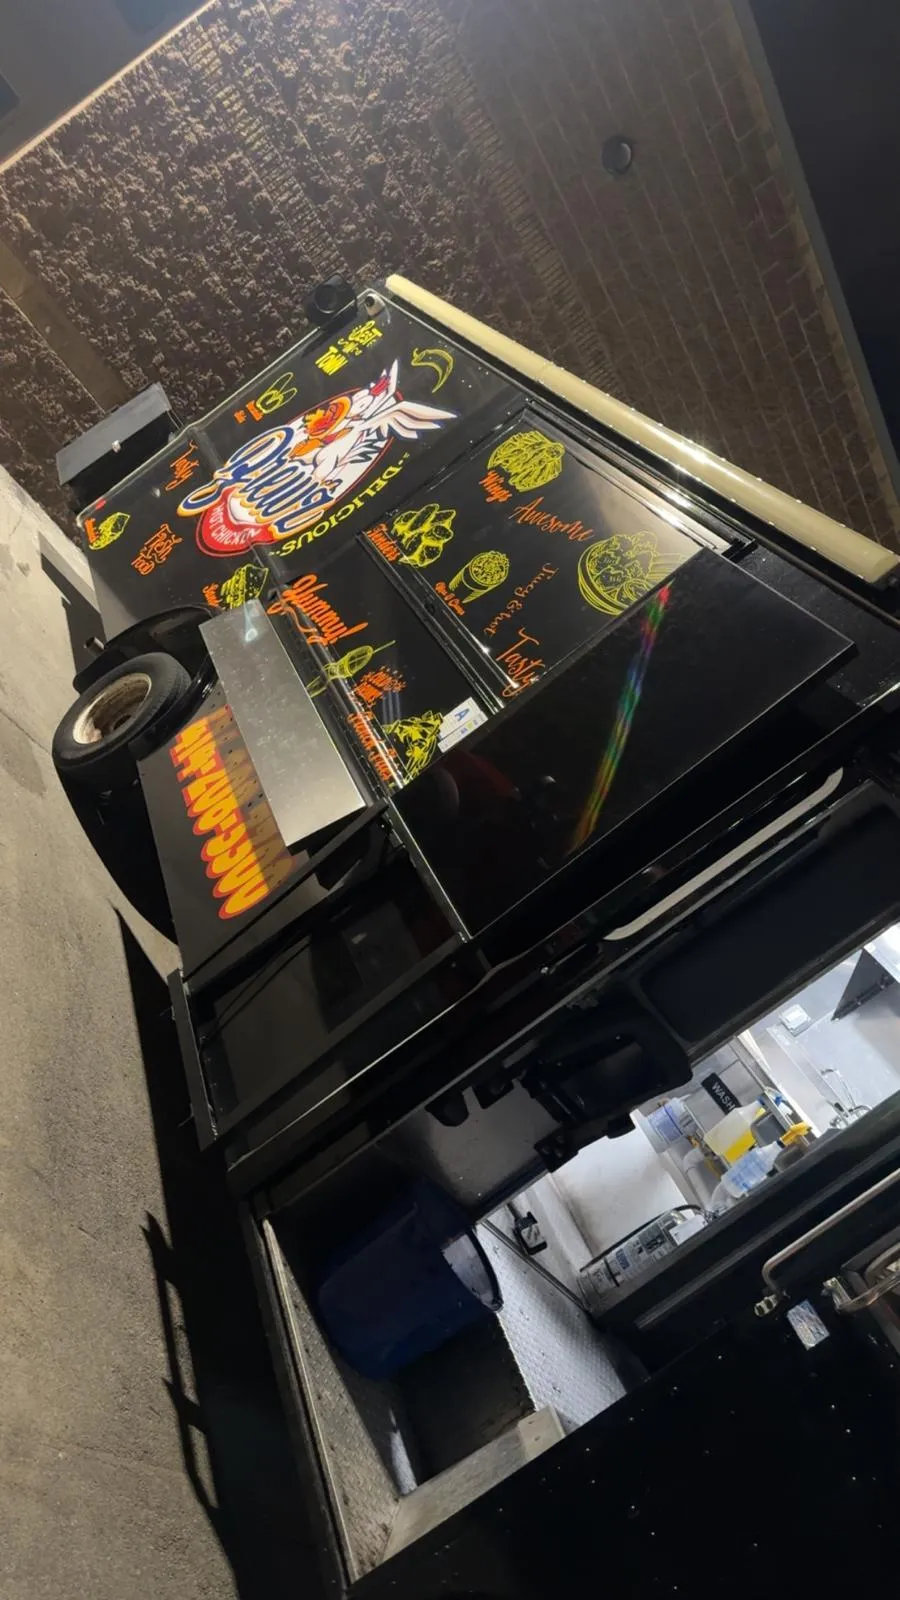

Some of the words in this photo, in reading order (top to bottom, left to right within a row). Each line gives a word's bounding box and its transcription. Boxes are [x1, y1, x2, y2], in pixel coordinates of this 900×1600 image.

[479, 470, 512, 502] Wings
[209, 502, 227, 531] HOT
[508, 497, 595, 541] Awesome
